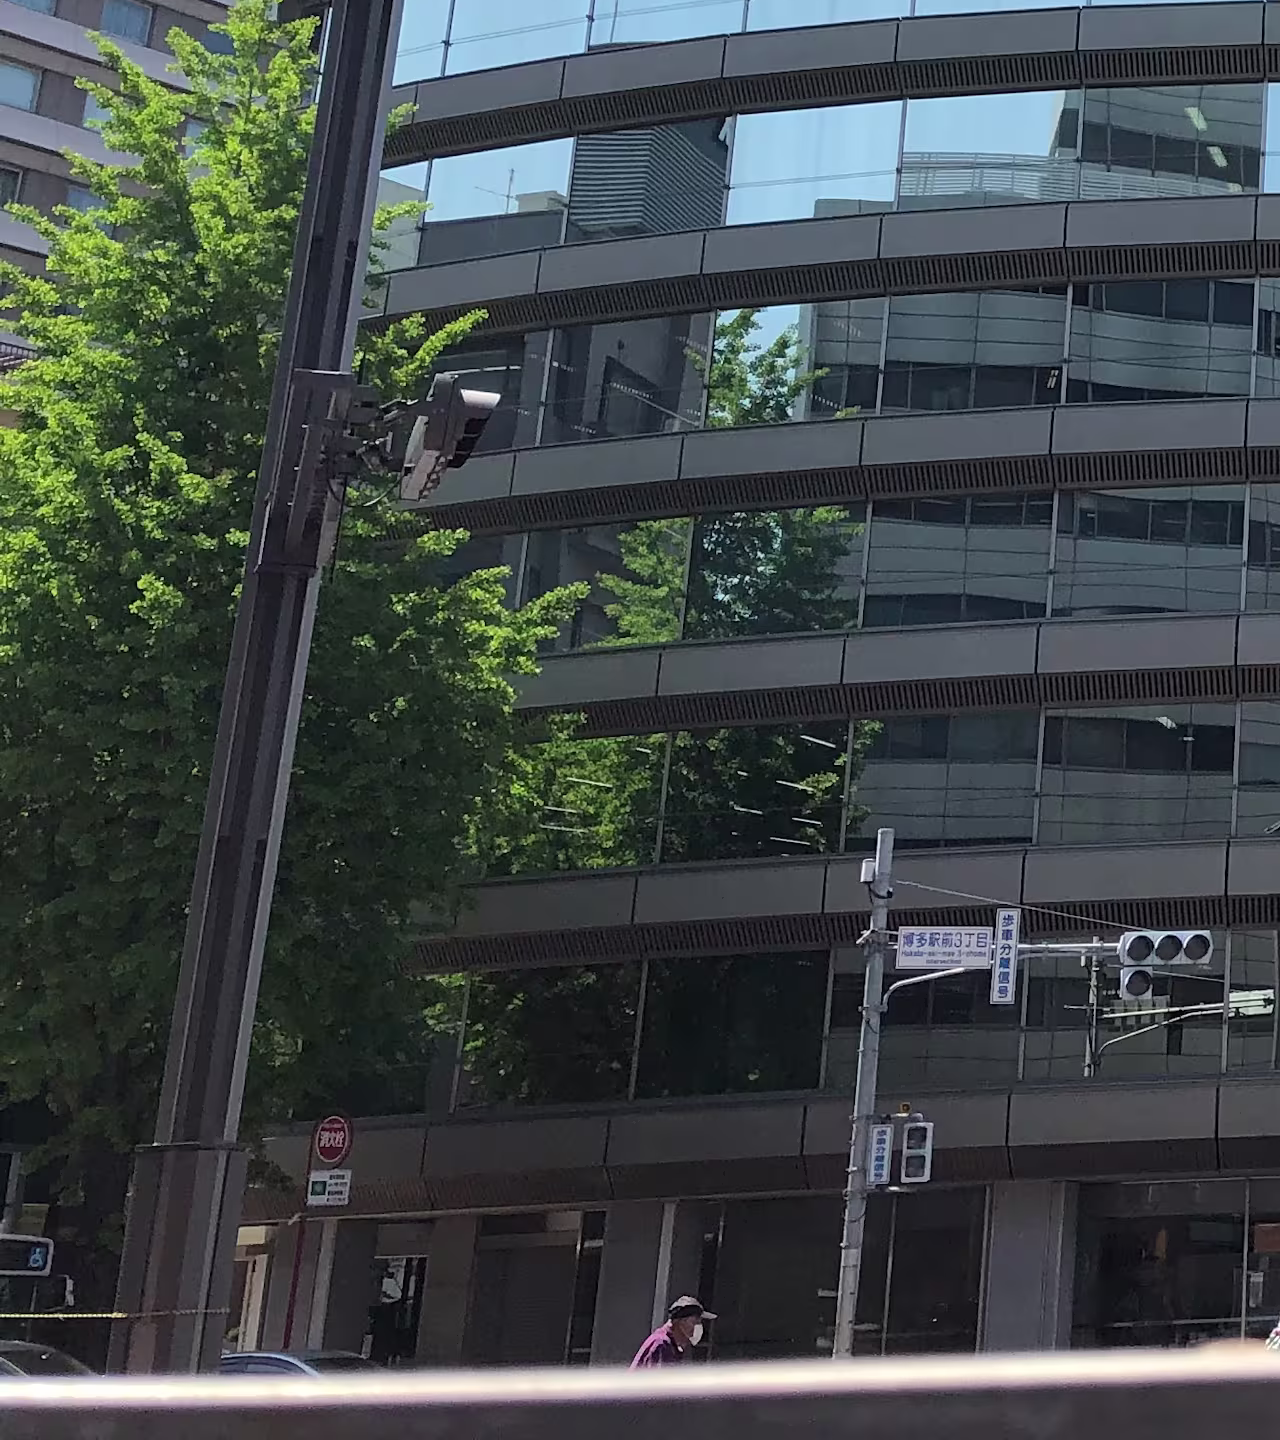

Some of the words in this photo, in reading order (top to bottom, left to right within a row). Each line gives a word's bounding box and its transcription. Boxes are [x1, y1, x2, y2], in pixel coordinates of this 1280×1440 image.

[902, 931, 988, 948] 博多駅前3丁目
[320, 1130, 345, 1148] 消火栓
